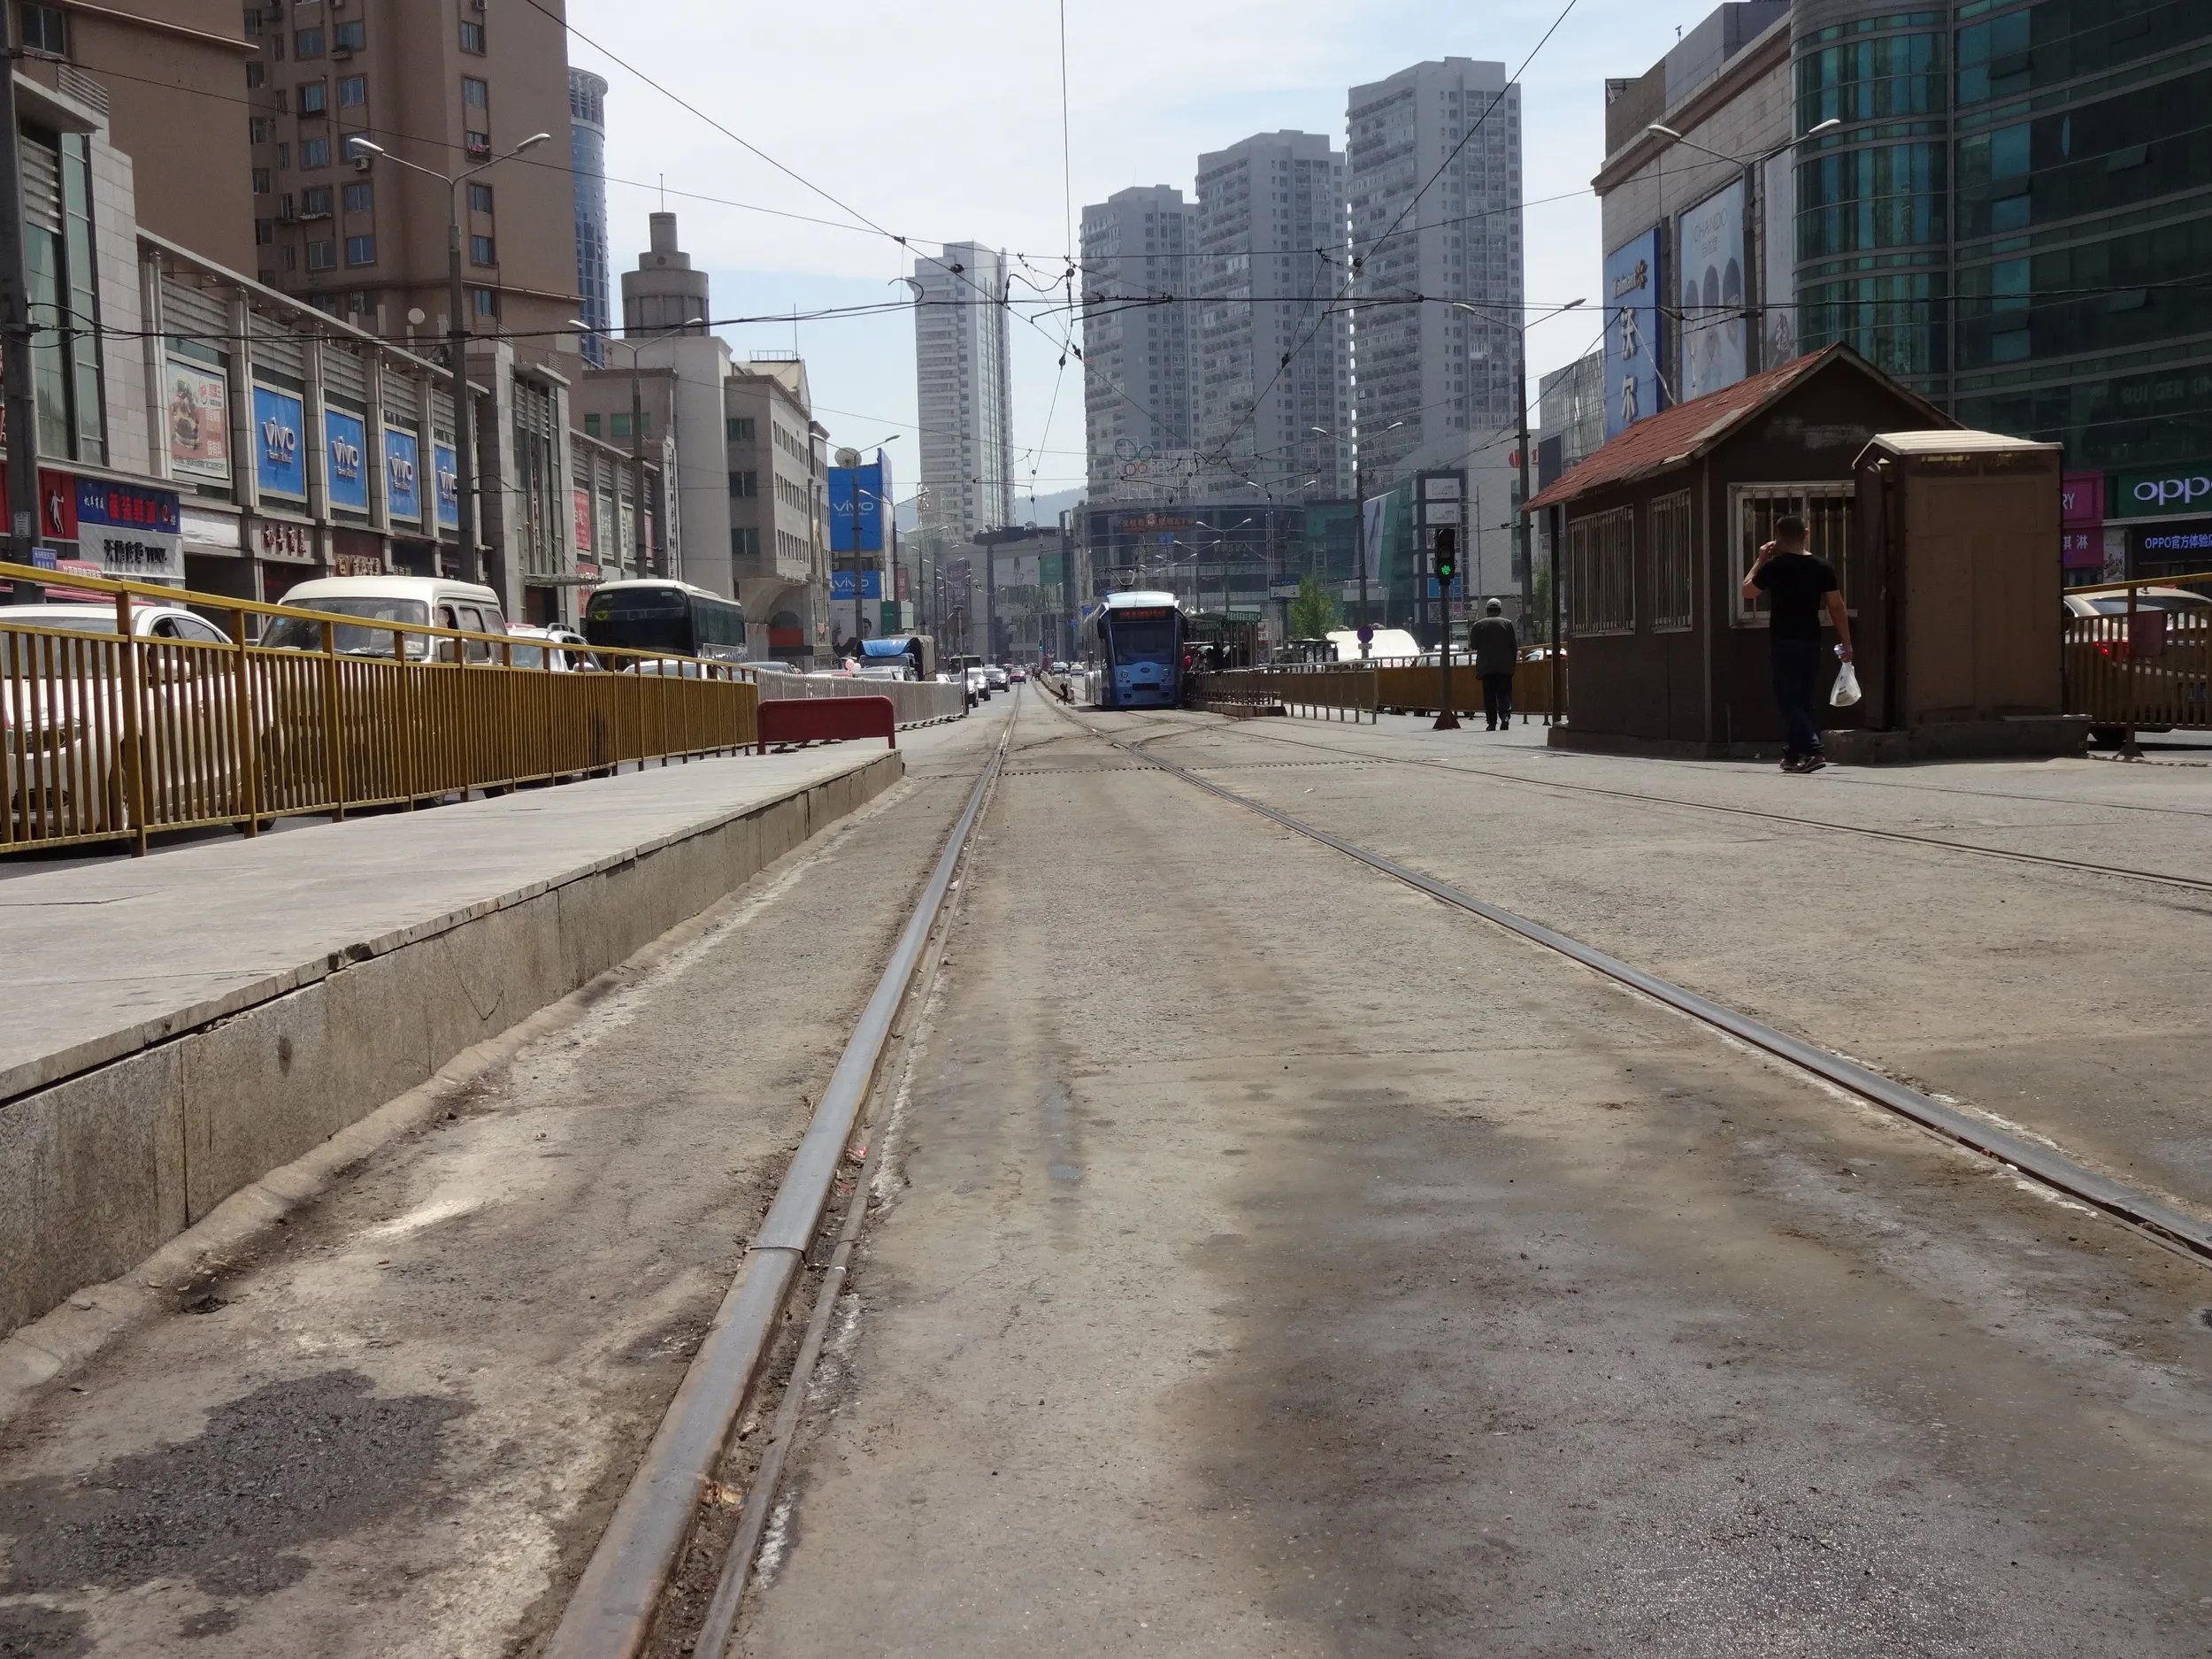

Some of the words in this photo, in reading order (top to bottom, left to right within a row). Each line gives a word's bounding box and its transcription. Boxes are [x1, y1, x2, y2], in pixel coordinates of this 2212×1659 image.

[1694, 208, 1727, 242] CHANDO
[1611, 269, 1637, 299] Walmart
[261, 417, 295, 450] vivo
[331, 435, 358, 467] vivo
[388, 452, 412, 480] vivo
[2134, 476, 2212, 505] opp
